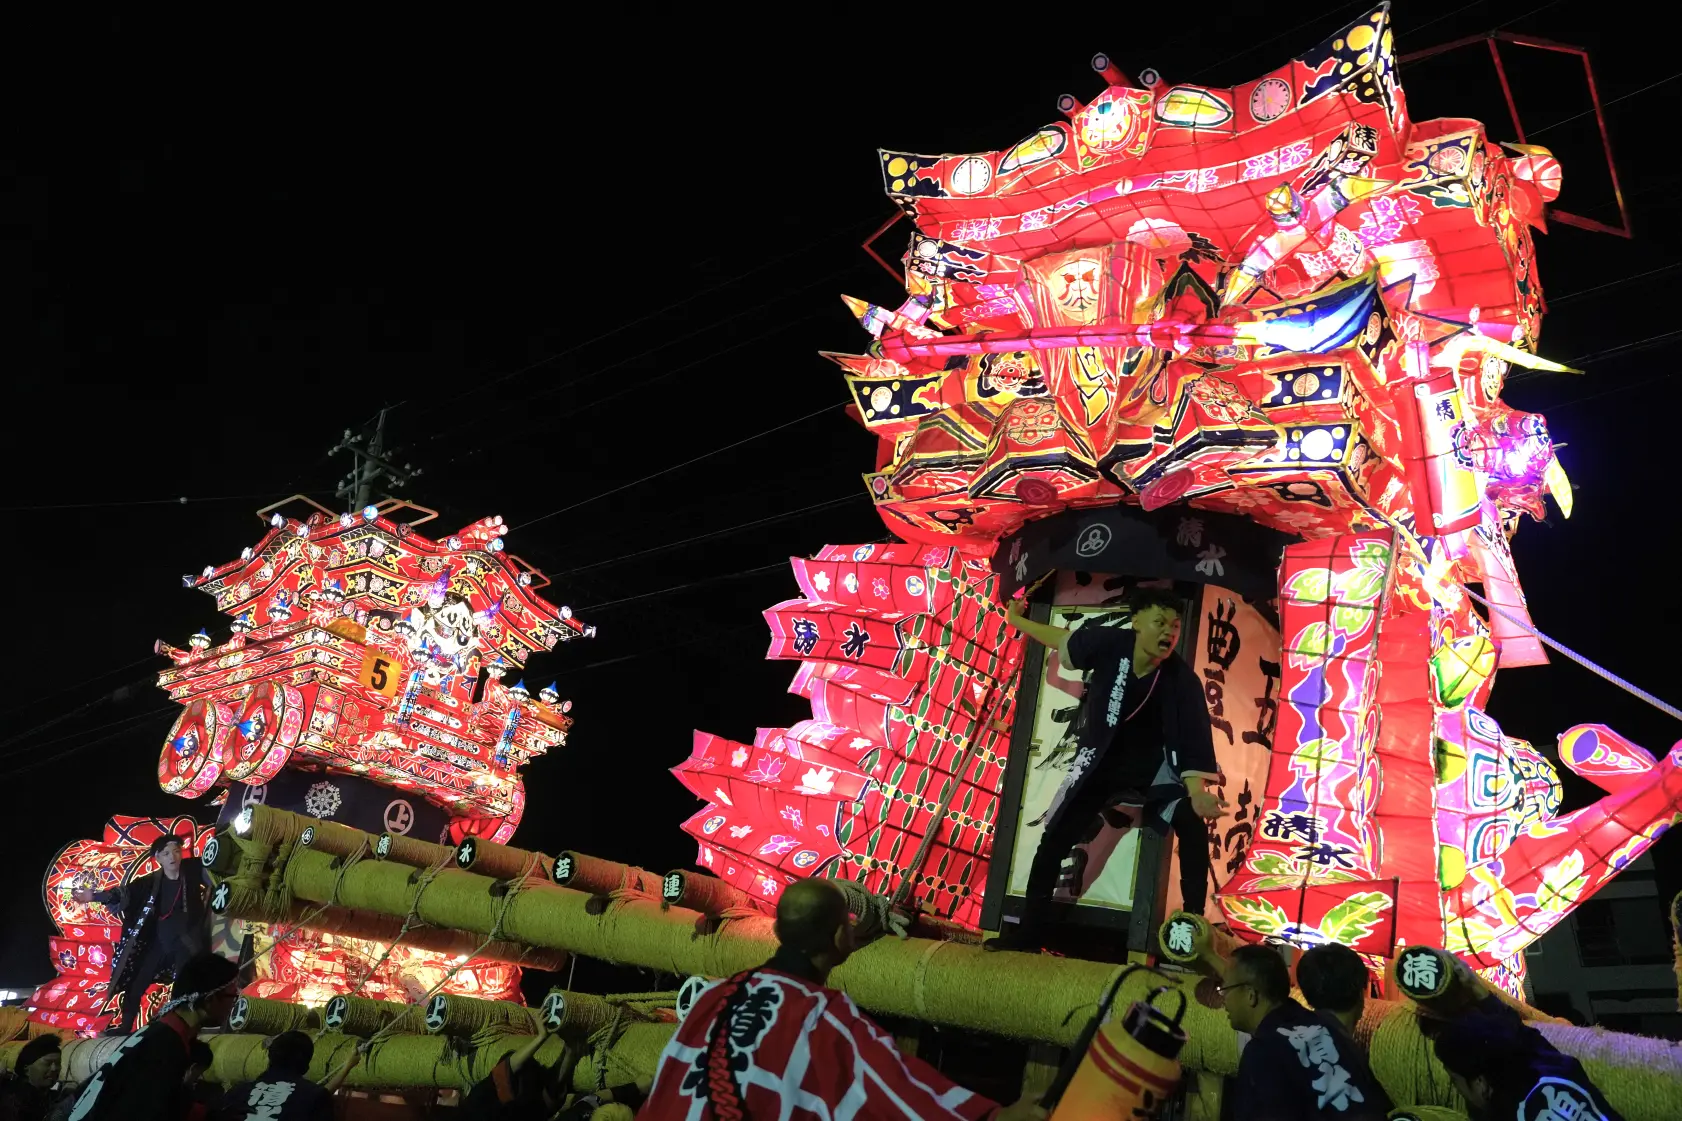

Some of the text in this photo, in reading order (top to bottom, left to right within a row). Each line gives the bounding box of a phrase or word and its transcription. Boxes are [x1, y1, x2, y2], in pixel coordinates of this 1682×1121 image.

[1177, 517, 1227, 577] 清水
[371, 658, 390, 690] 5
[387, 802, 411, 832] 上
[459, 844, 473, 863] 水
[1263, 812, 1354, 868] 清水
[555, 858, 571, 879] 若
[211, 883, 229, 910] 水
[663, 874, 680, 897] 連
[1168, 921, 1194, 953] 清
[1403, 953, 1438, 990] 清
[326, 997, 345, 1026] 上
[426, 996, 446, 1024] 上
[1276, 1024, 1365, 1112] 清水
